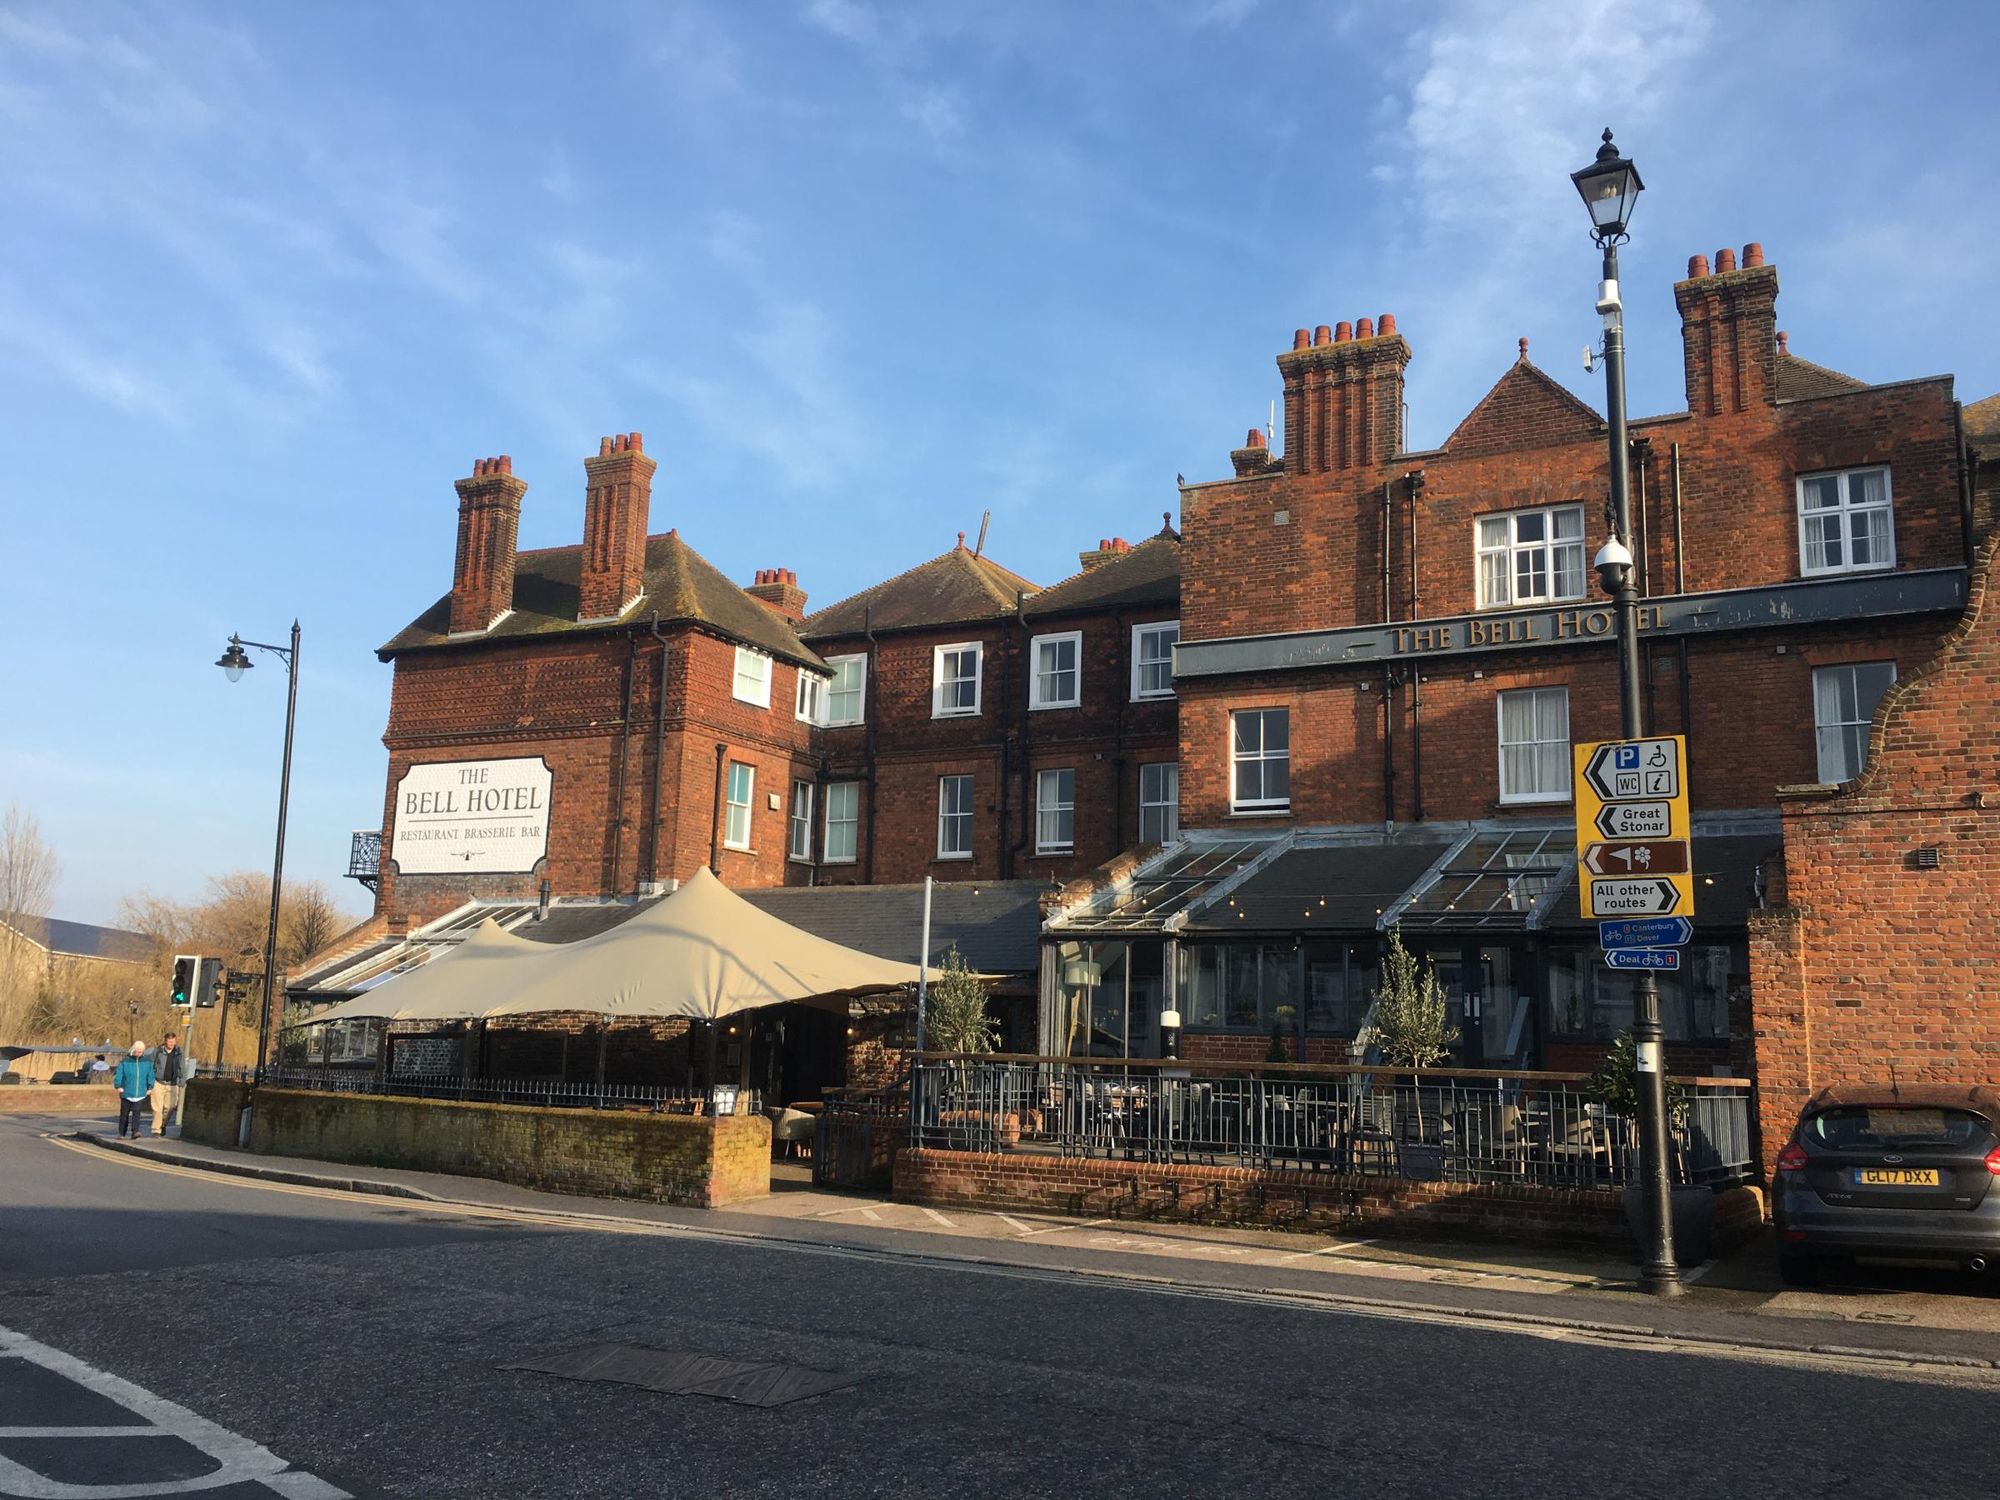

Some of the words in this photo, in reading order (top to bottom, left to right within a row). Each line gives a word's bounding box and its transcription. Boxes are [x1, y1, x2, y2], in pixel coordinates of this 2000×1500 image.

[1391, 627, 1453, 652] THE
[1470, 617, 1540, 645] BELL
[1557, 606, 1671, 637] HOEL
[1620, 748, 1635, 767] P
[459, 768, 489, 785] THE
[1619, 777, 1637, 791] WC
[405, 791, 459, 815] BELL
[467, 786, 542, 812] HOTEL
[1623, 808, 1661, 820] Great
[1620, 820, 1665, 832] Stonar
[400, 828, 459, 841] RESTAURANT
[464, 826, 516, 839] BRASSERIE
[521, 825, 541, 838] BAR
[1597, 885, 1614, 896] All
[1620, 884, 1655, 896] other
[1604, 898, 1647, 909] routes
[1631, 923, 1675, 932] Canterbury
[1619, 954, 1641, 963] Deal
[1867, 1170, 1898, 1183] GL17
[1904, 1171, 1933, 1183] DXX
